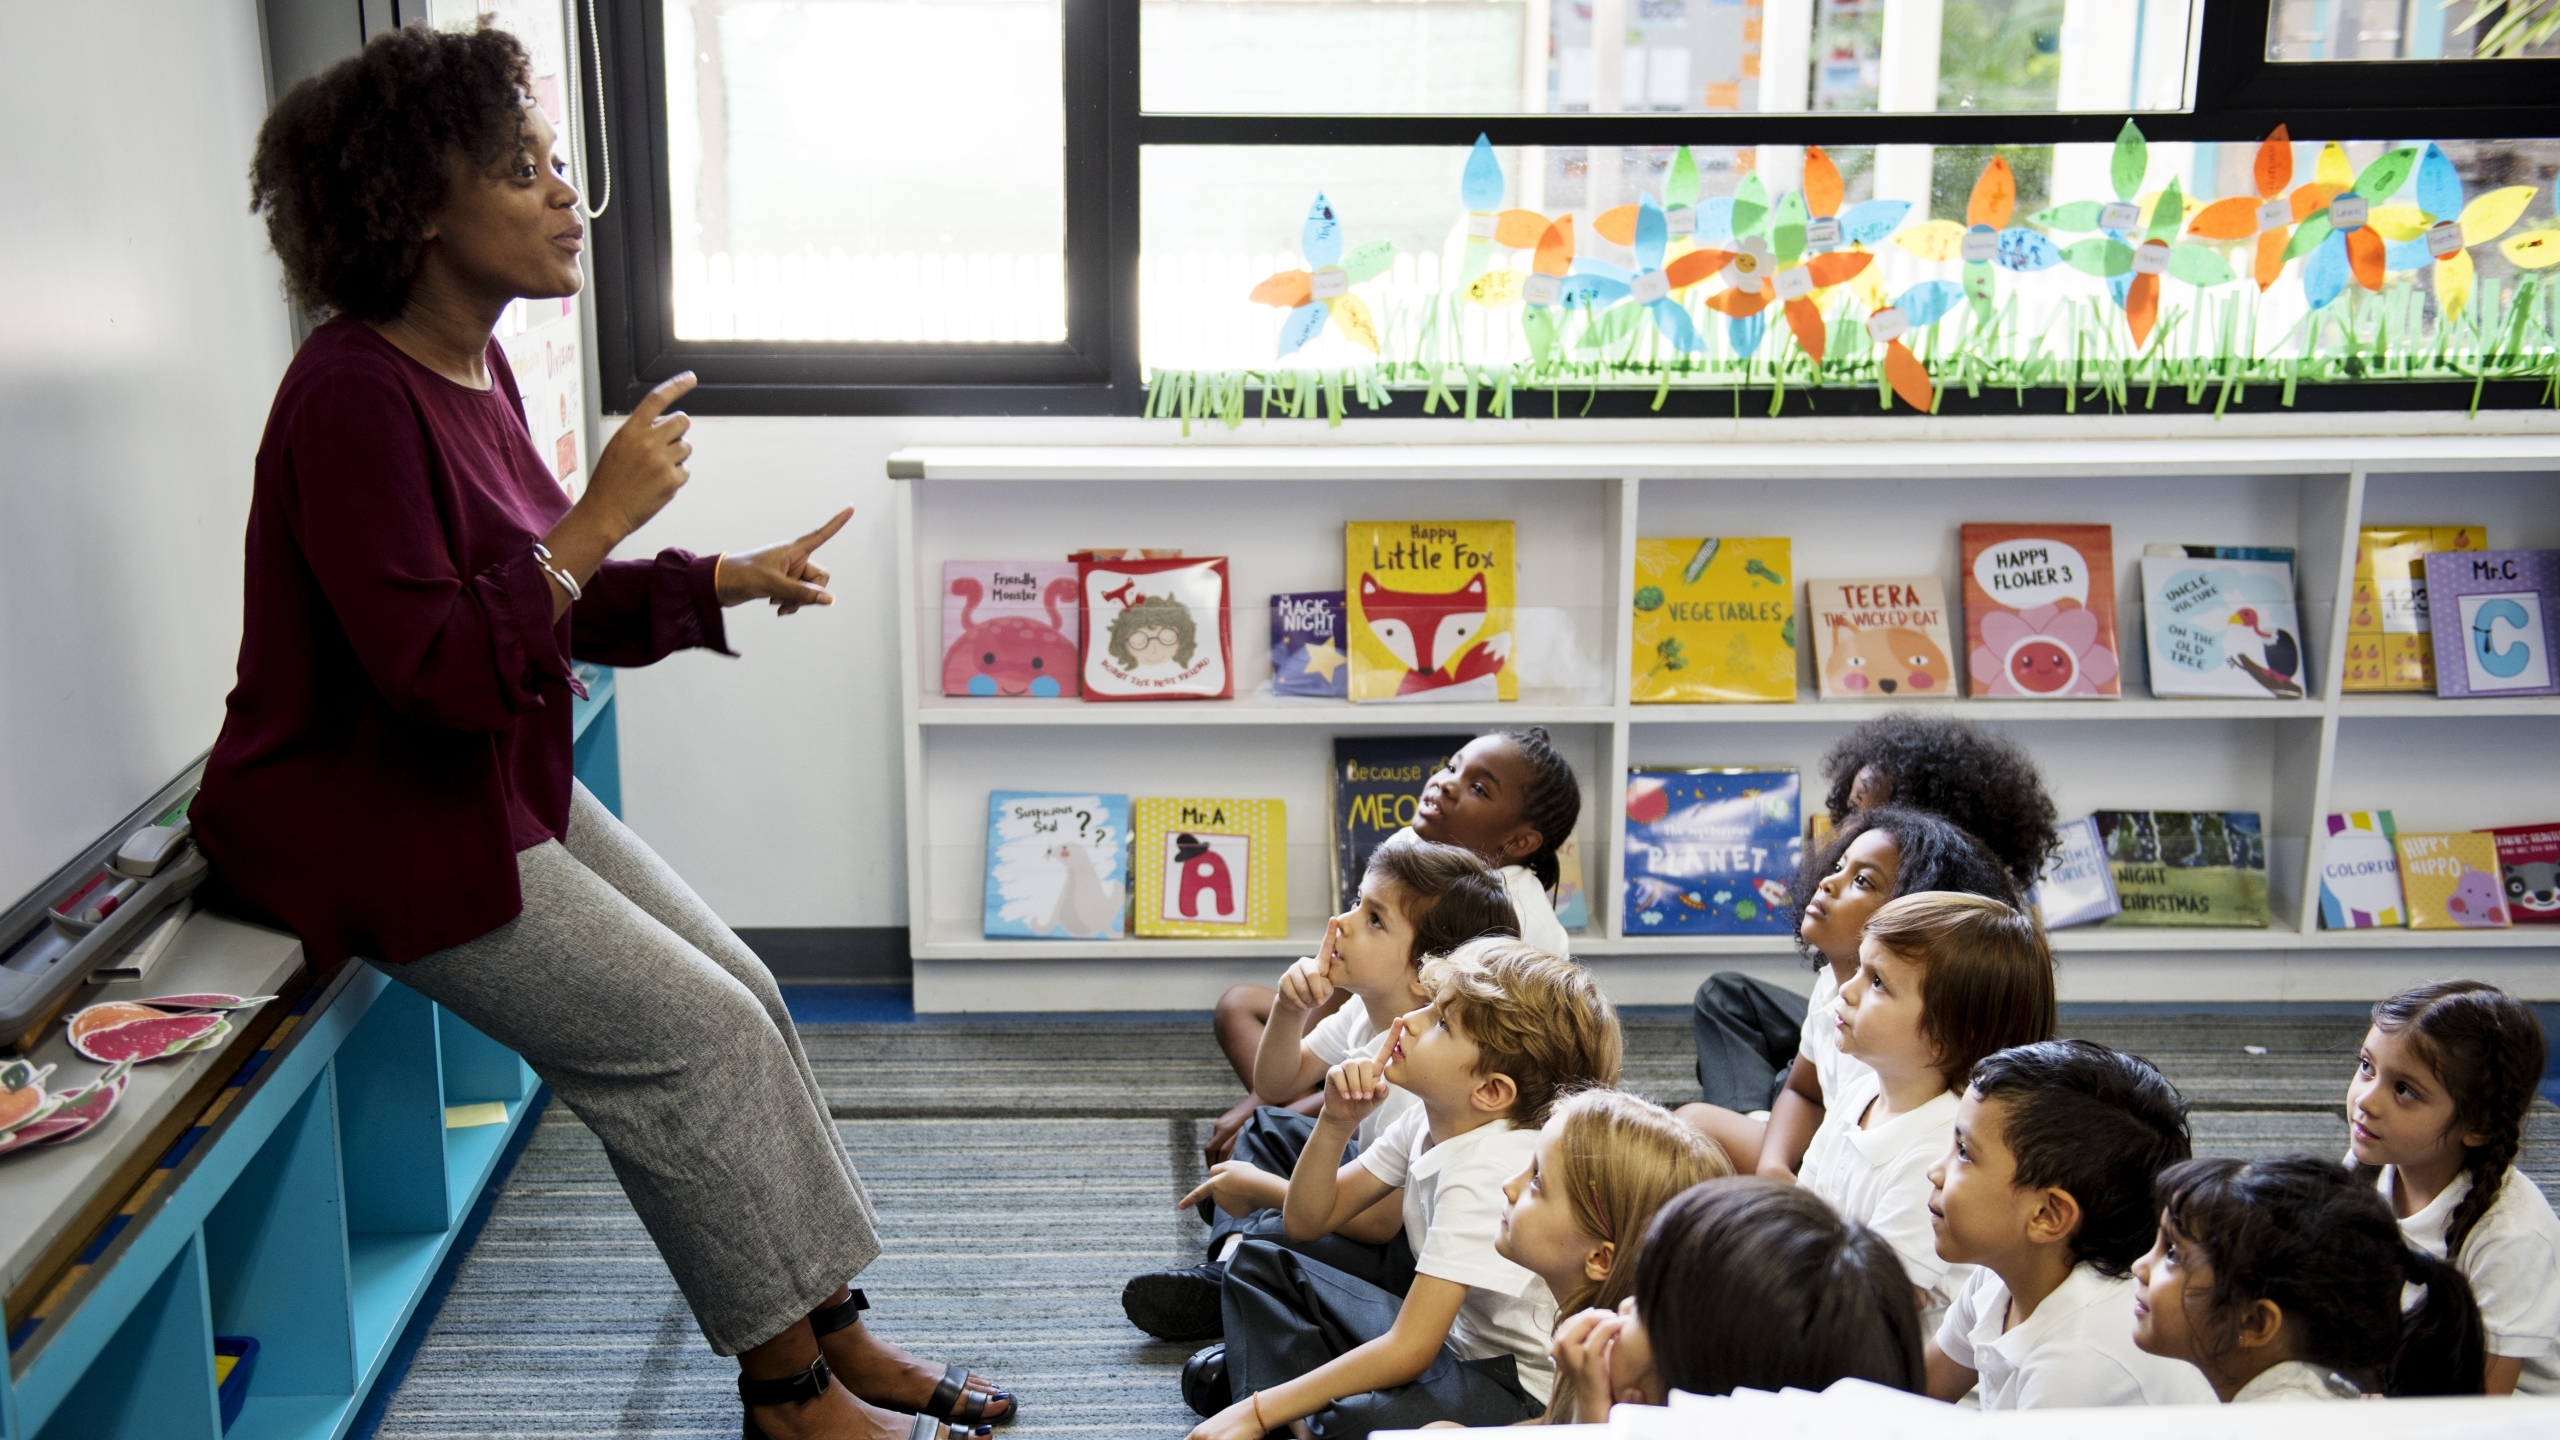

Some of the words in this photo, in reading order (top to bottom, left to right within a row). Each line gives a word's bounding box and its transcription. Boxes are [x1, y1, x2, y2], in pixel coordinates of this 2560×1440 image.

[1411, 524, 1457, 544] Happy
[1373, 541, 1442, 570] Little
[1453, 544, 1495, 570] Fox
[1996, 547, 2049, 569] HAPPY
[1994, 570, 2058, 591] FLOWER
[2061, 566, 2073, 583] 3
[2472, 559, 2518, 580] Mr.C
[993, 572, 1037, 589] Friendly
[2166, 573, 2209, 602] UNCLE
[992, 588, 1037, 601] Monster
[1839, 584, 1921, 610] TEERA
[2171, 586, 2220, 614] VULTURE
[1278, 599, 1331, 617] MAGIC
[1667, 601, 1783, 622] VEGETABLES
[1822, 611, 1849, 627] THE
[1852, 610, 1907, 627] WICKED
[1912, 609, 1939, 626] CAT
[1284, 614, 1336, 632] NIGHT
[2168, 624, 2186, 635] ON
[2193, 627, 2215, 647] THE
[2176, 639, 2205, 656] OLD
[2170, 650, 2206, 671] TREE
[1131, 676, 1151, 687] THE
[1154, 678, 1176, 687] BEST
[1179, 658, 1210, 682] FRIEND
[1348, 759, 1422, 783] Because
[1014, 805, 1073, 820] Suspicious
[1181, 807, 1226, 826] Mr.A
[1347, 793, 1421, 832] MEO
[1033, 820, 1058, 833] Seal
[1076, 810, 1092, 838] ?
[1095, 829, 1106, 847] ?
[2401, 836, 2450, 860] HIPPY
[1647, 843, 1768, 877] PLANET
[2326, 859, 2396, 878] COLORFU
[2409, 856, 2461, 878] HIPPO
[2051, 861, 2097, 884] TORIES
[2118, 866, 2166, 884] NIGHT
[2122, 894, 2210, 913] CHRISTMAS
